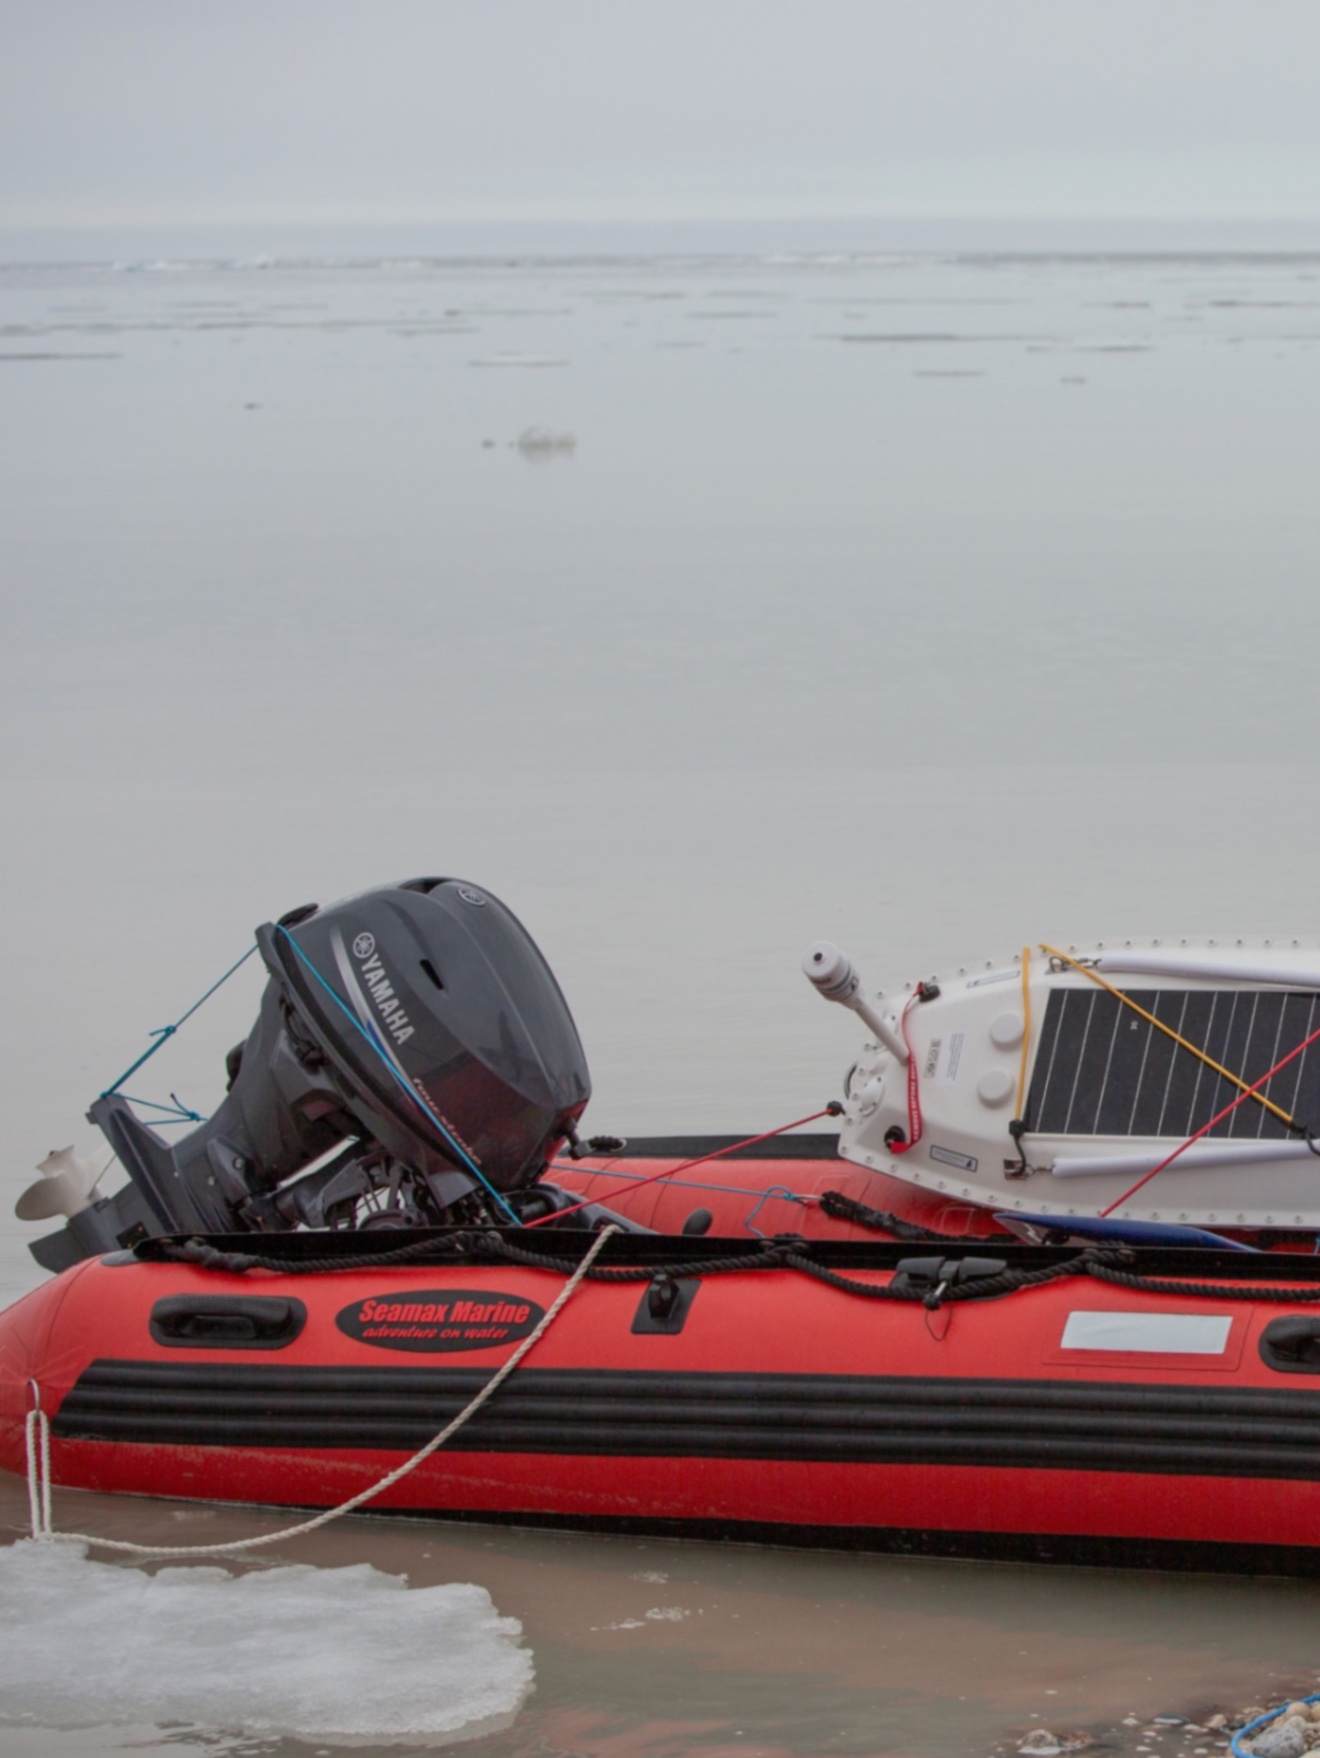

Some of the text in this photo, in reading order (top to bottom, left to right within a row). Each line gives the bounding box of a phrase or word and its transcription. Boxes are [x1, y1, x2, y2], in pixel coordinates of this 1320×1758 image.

[361, 953, 415, 1045] YAMAHA
[359, 1300, 531, 1324] Seamax Marine
[362, 1325, 508, 1339] adventure on water
